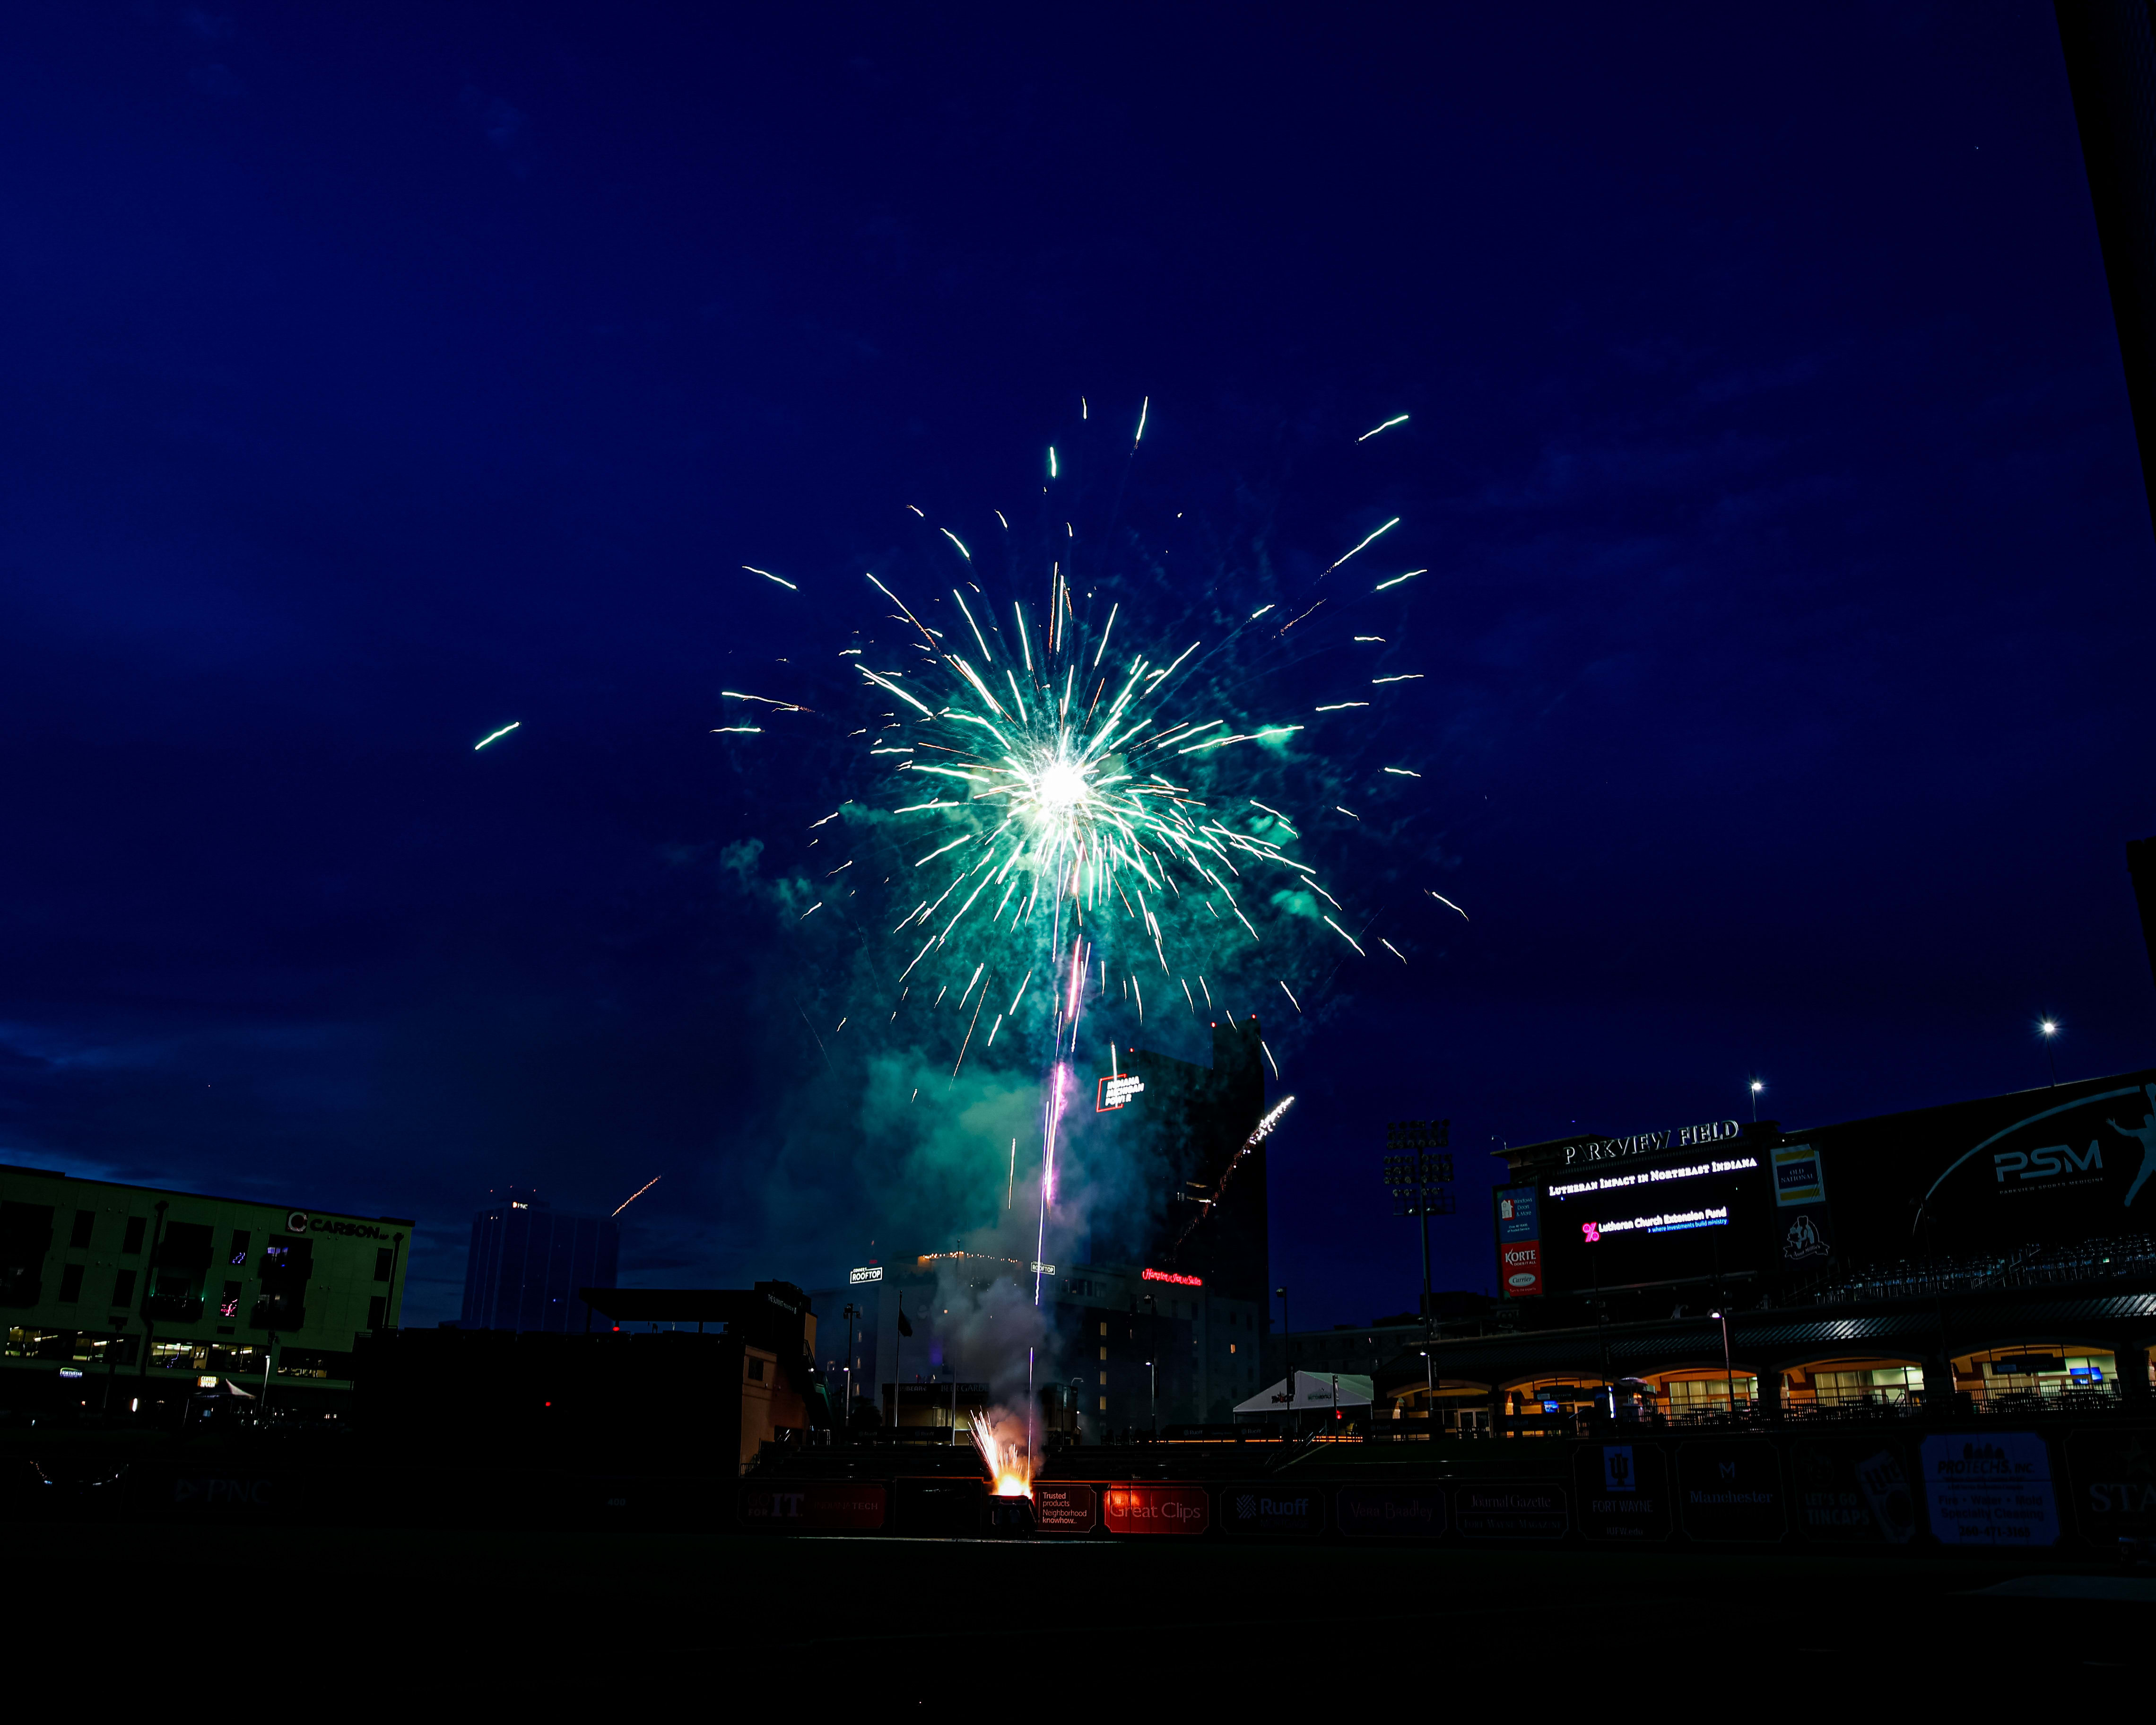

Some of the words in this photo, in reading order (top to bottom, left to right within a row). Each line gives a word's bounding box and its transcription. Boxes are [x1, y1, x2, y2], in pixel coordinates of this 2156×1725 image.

[1107, 1076, 1139, 1089] INDIANA
[1106, 1083, 1144, 1098] MICHIGAN
[1564, 1130, 1671, 1164] PARKVIEW
[1678, 1120, 1739, 1146] FIELD
[1994, 1139, 2104, 1183] PSM
[1781, 1173, 1814, 1183] NATIONAL
[1599, 1220, 1634, 1232] Lutheran
[1634, 1214, 1663, 1228] Church
[1664, 1210, 1704, 1224] Extension
[1705, 1206, 1727, 1219] Fund
[1708, 1219, 1727, 1227] ministry
[310, 1219, 380, 1238] CARSON
[1505, 1248, 1536, 1266] KORTE
[852, 1270, 880, 1281] ROOFTOP
[1142, 1268, 1170, 1282] Hampton
[1170, 1273, 1183, 1283] Inn
[1187, 1275, 1201, 1286] Suites
[1043, 1491, 1066, 1499] Trusted
[1688, 1490, 1773, 1503] Manchester
[1838, 1491, 1857, 1506] GO
[1043, 1499, 1070, 1508] products
[1260, 1498, 1309, 1516] Ruoff
[1592, 1499, 1617, 1513] FORT
[1618, 1499, 1653, 1513] WAYNE
[1043, 1509, 1087, 1518] Neighborhood
[1110, 1502, 1157, 1517] Great
[1161, 1502, 1201, 1523] Clips
[1350, 1501, 1380, 1519] Vera
[1384, 1499, 1434, 1524] Bradley
